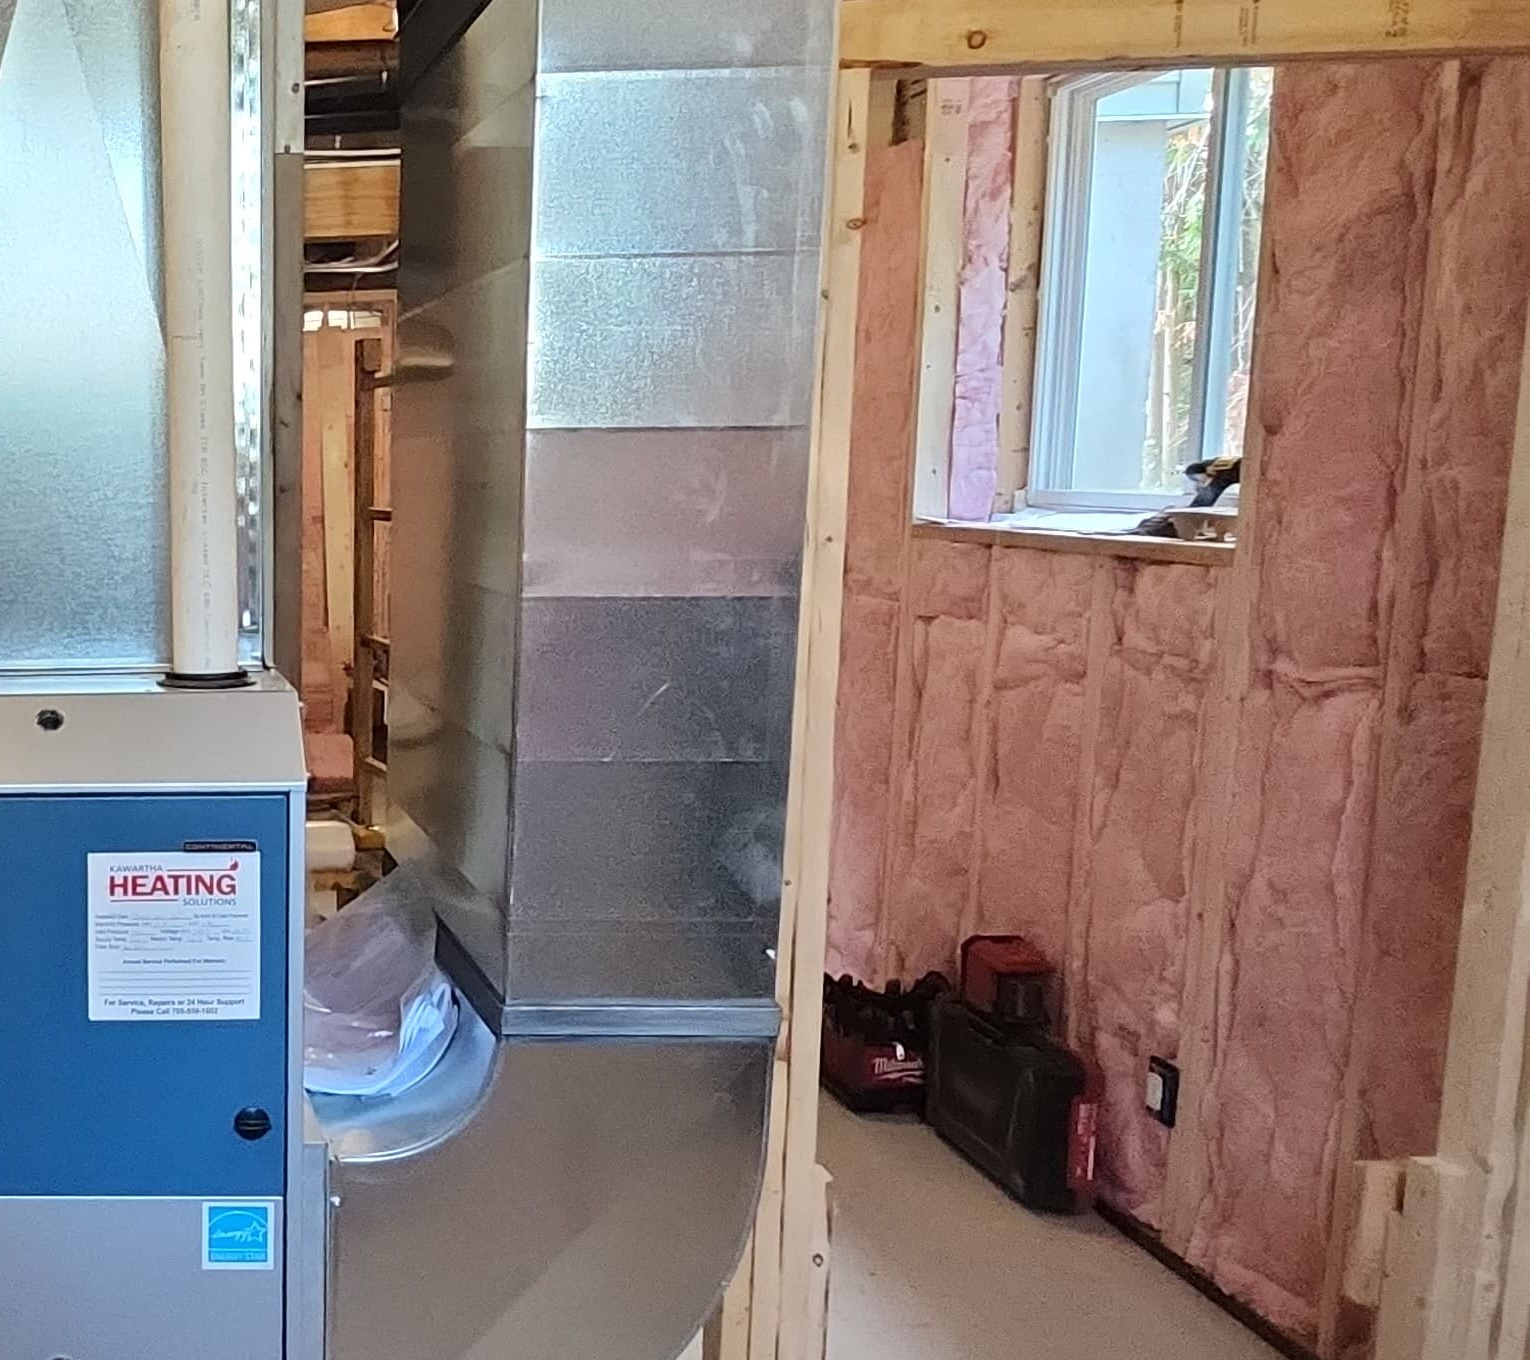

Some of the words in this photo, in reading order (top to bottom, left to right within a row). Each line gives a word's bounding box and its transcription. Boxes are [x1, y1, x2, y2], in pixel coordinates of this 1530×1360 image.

[109, 864, 164, 873] KAWARTHA
[108, 874, 237, 896] HEATING
[183, 898, 236, 907] SOLUTIONS
[216, 998, 245, 1007] Support
[156, 1007, 170, 1015] Call
